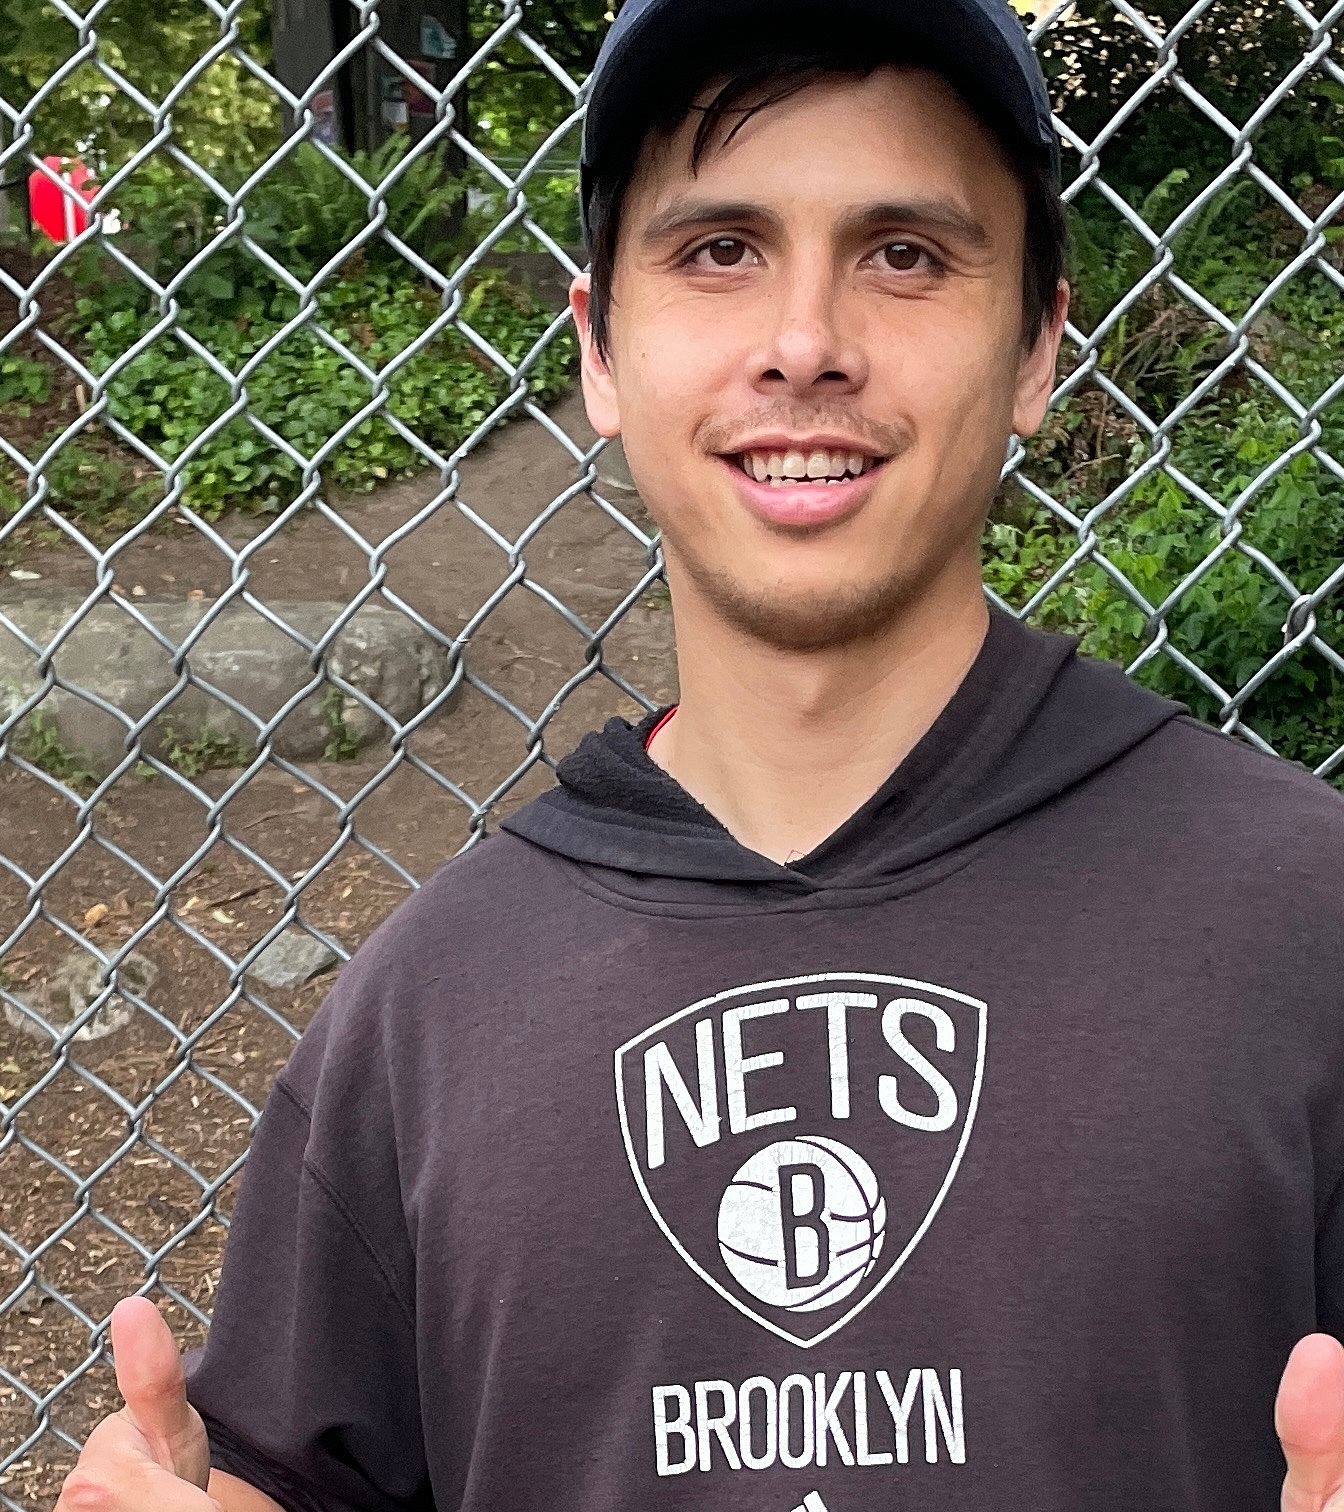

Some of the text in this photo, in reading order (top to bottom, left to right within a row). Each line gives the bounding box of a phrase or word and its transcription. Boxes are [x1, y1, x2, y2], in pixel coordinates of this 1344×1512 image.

[643, 991, 958, 1169] NETS
[778, 1163, 830, 1290] B
[652, 1368, 967, 1477] BROOKLYN
